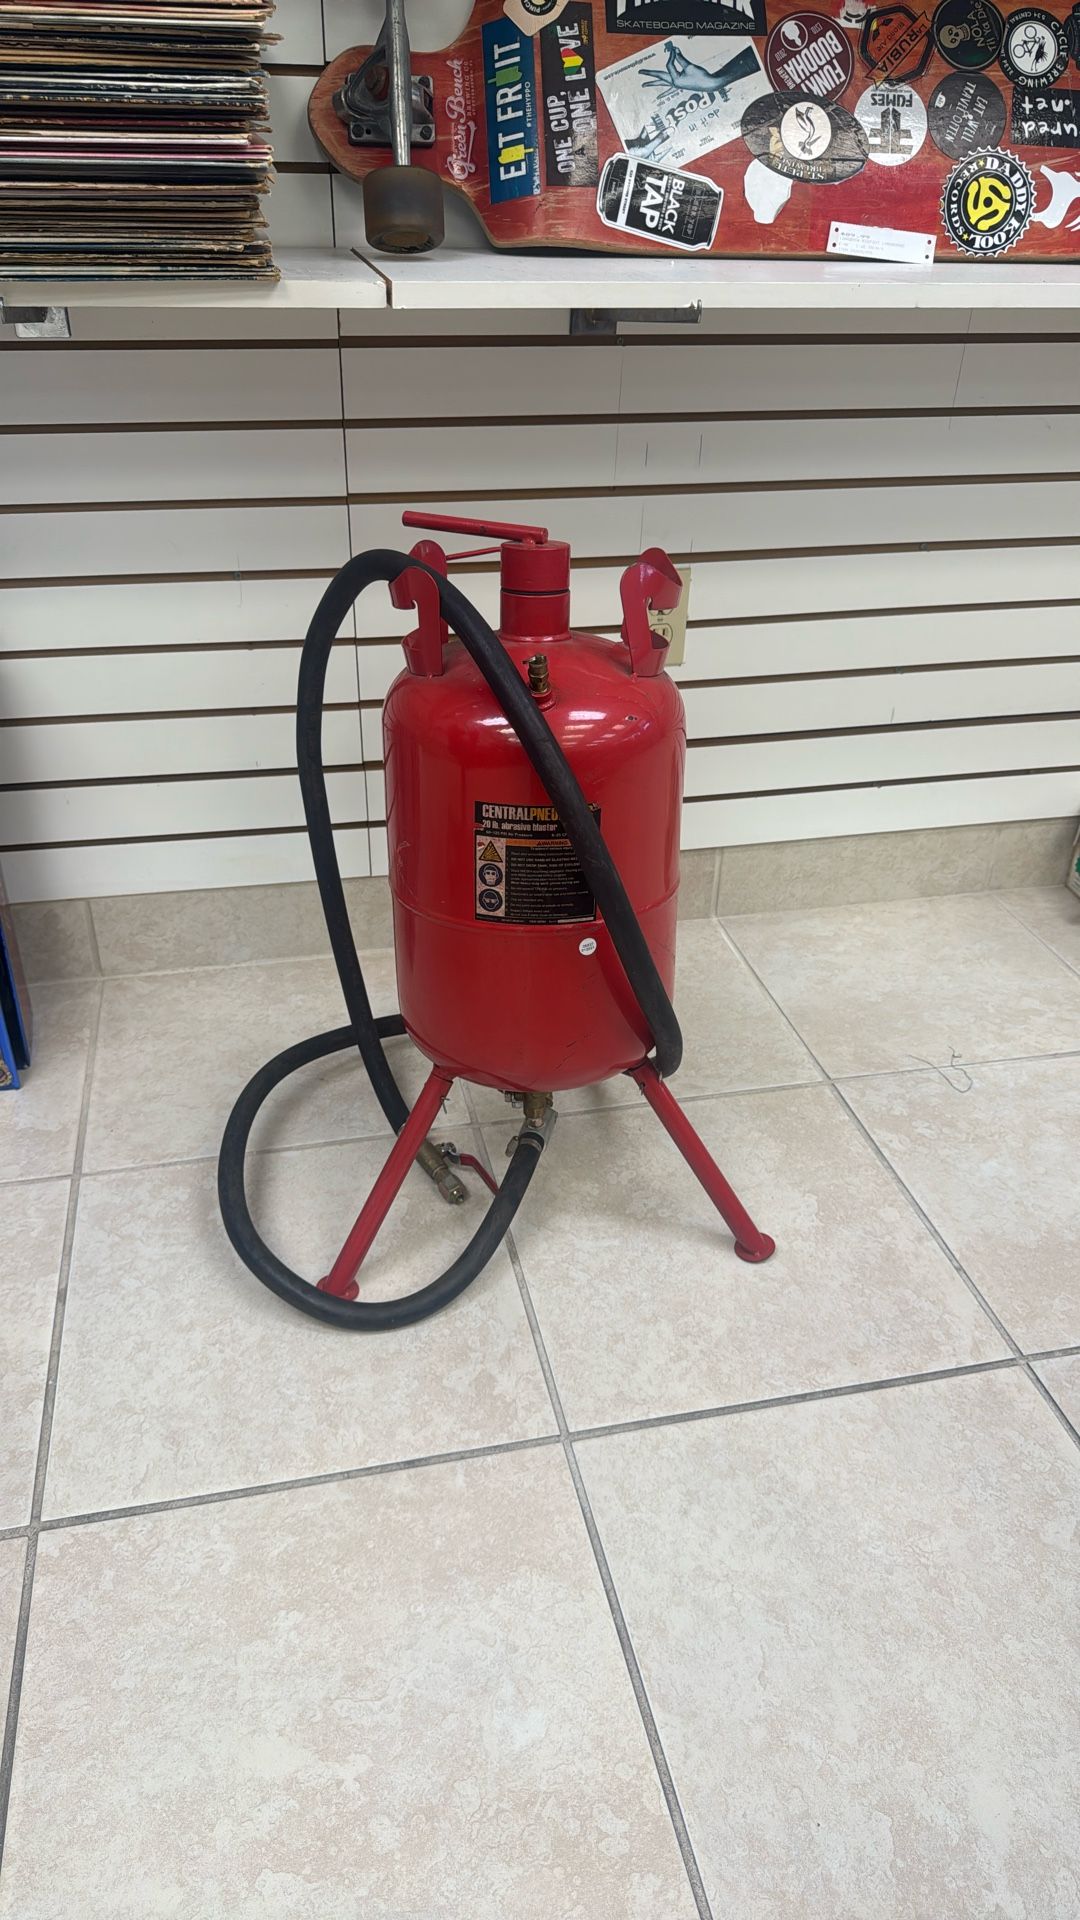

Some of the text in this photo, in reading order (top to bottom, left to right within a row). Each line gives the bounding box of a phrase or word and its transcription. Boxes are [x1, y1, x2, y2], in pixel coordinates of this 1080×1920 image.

[616, 19, 756, 30] SKATEBOARD MAGAZINE
[967, 10, 986, 47] NOLA
[1050, 21, 1068, 59] CYCLE
[774, 48, 788, 62] 2010
[783, 29, 843, 84] BUDDHA
[877, 29, 918, 73] RUBIA
[775, 67, 796, 90] BREWERY
[568, 88, 597, 133] ONE
[665, 91, 715, 128] Post
[708, 108, 720, 120] do
[870, 92, 913, 108] FUMES
[944, 81, 977, 143] TRAVEL OFTEN
[962, 110, 973, 120] &
[445, 57, 477, 181] Green Bench
[547, 92, 576, 174] ONE CUP,
[700, 117, 707, 128] it
[961, 96, 988, 143] EAT WELL
[775, 162, 804, 178] PETE
[640, 175, 668, 229] TAP
[661, 178, 685, 234] BLACK
[950, 162, 979, 235] RECORDS
[969, 156, 1028, 248] DADDY KOOL
[482, 804, 560, 821] CENTRALPNEU
[482, 819, 491, 828] 20
[501, 821, 531, 831] abrasive
[532, 823, 558, 832] blaster
